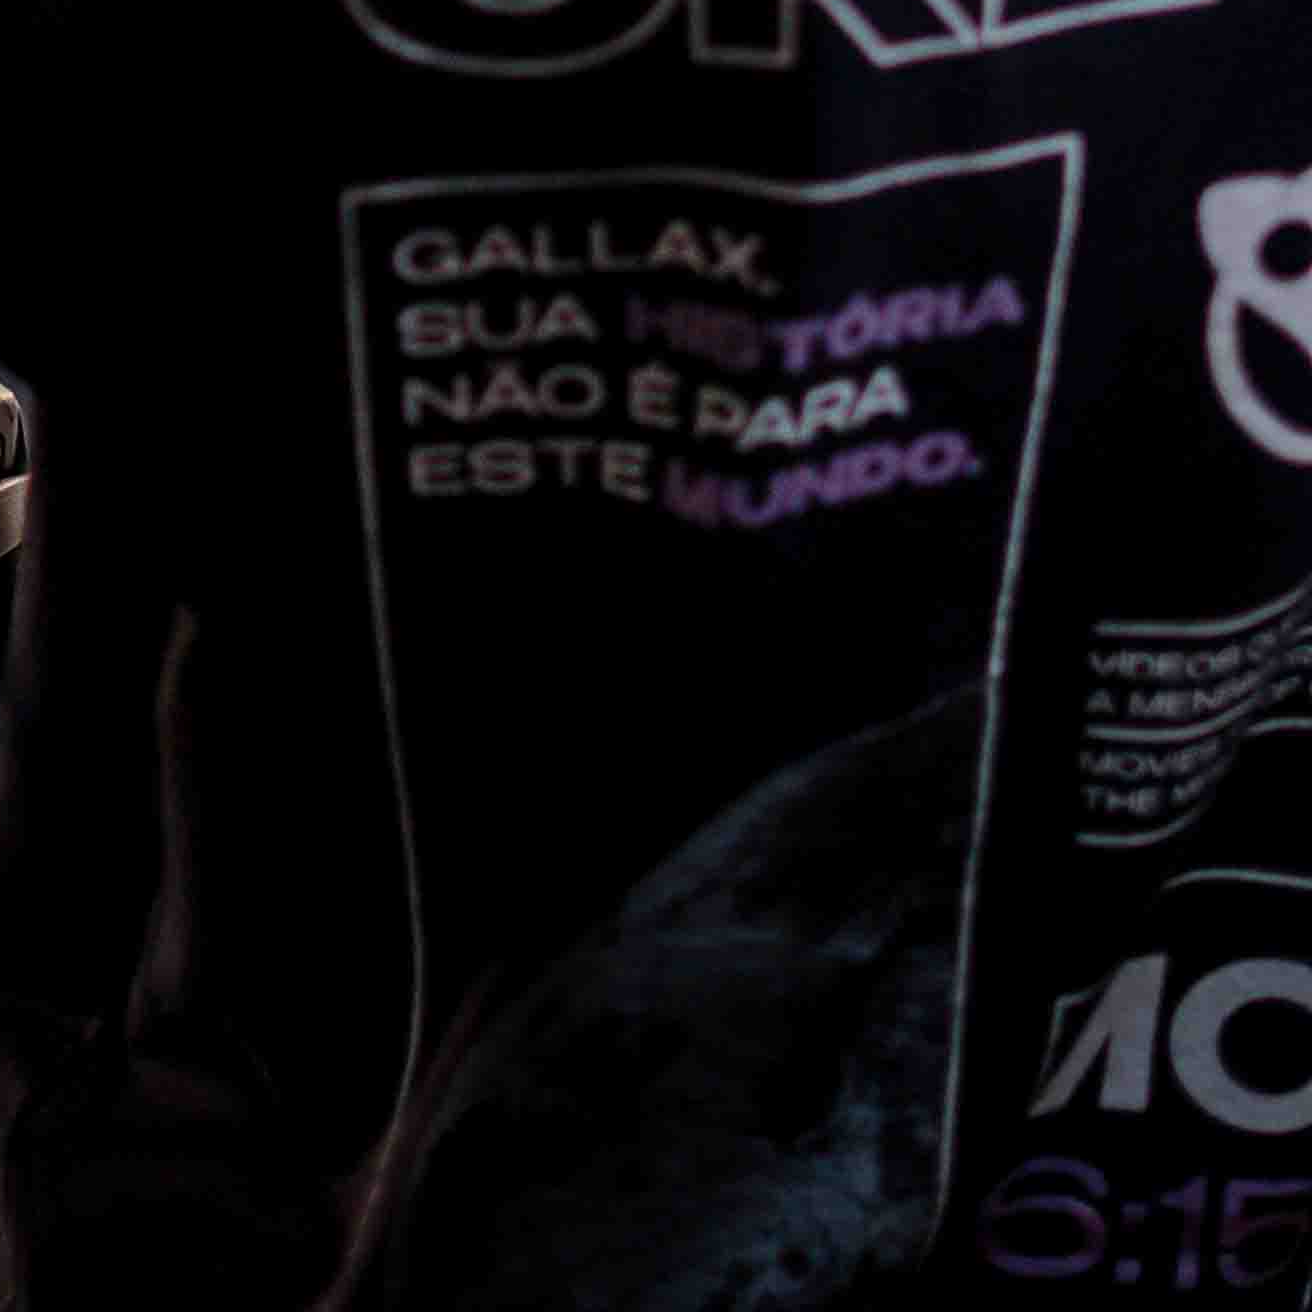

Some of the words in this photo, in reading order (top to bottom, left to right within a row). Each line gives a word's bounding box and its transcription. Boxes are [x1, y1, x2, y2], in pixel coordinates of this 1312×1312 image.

[396, 292, 599, 357] SUA
[401, 360, 605, 427] NÃO
[692, 366, 911, 454] PARA
[408, 437, 651, 502] ESTE
